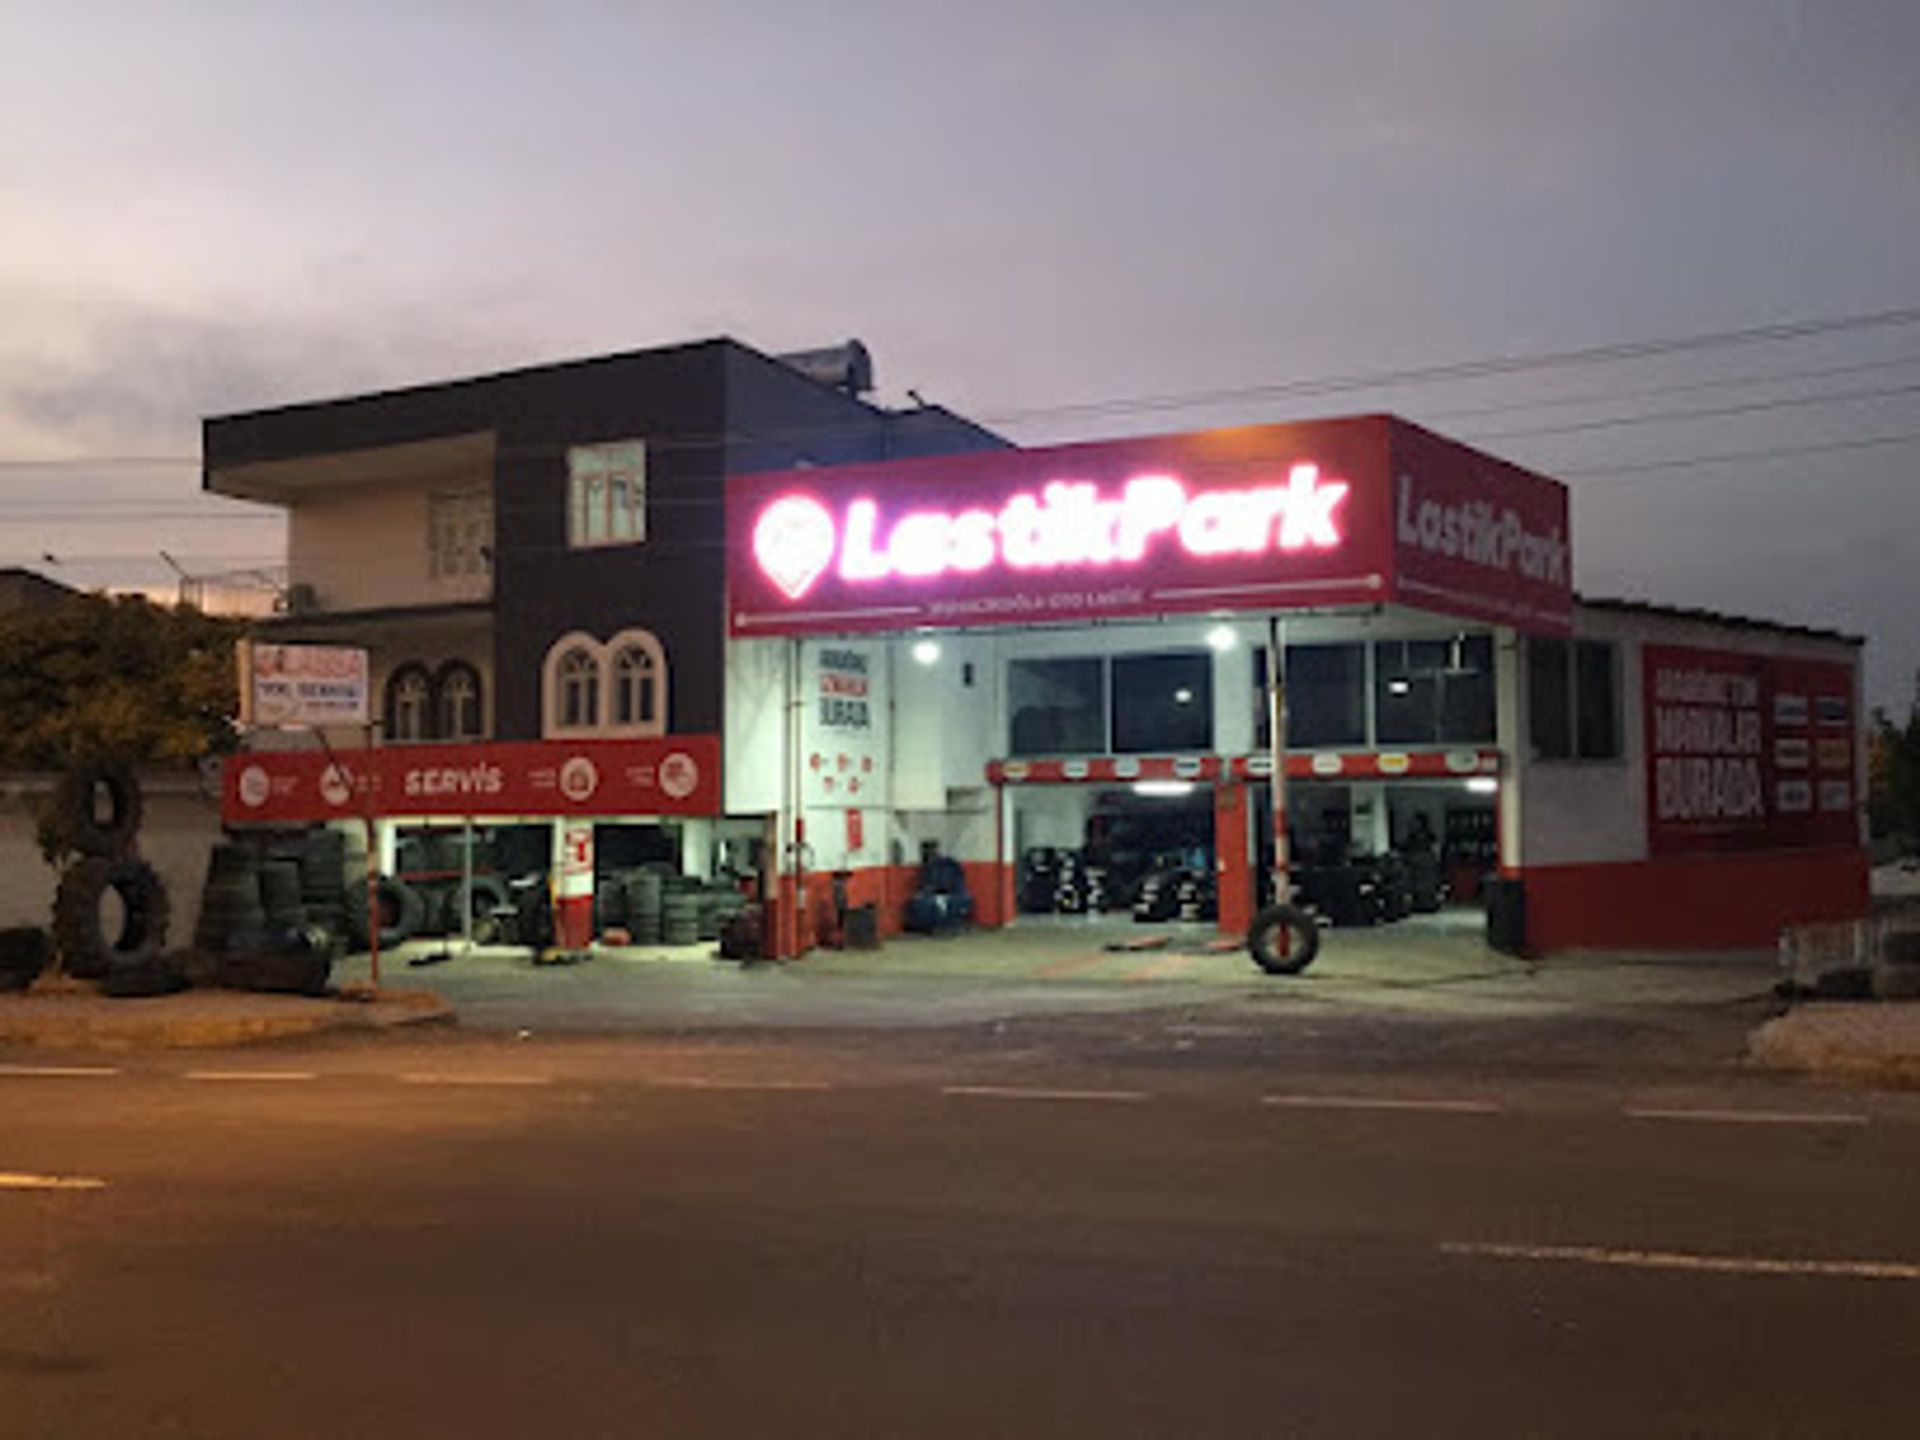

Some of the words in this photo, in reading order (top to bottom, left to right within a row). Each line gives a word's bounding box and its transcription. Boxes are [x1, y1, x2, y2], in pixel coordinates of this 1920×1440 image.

[840, 464, 1349, 580] LastikPark
[1398, 475, 1566, 586] LastikPark
[404, 761, 506, 794] SERVİS
[1656, 757, 1765, 821] BURADA
